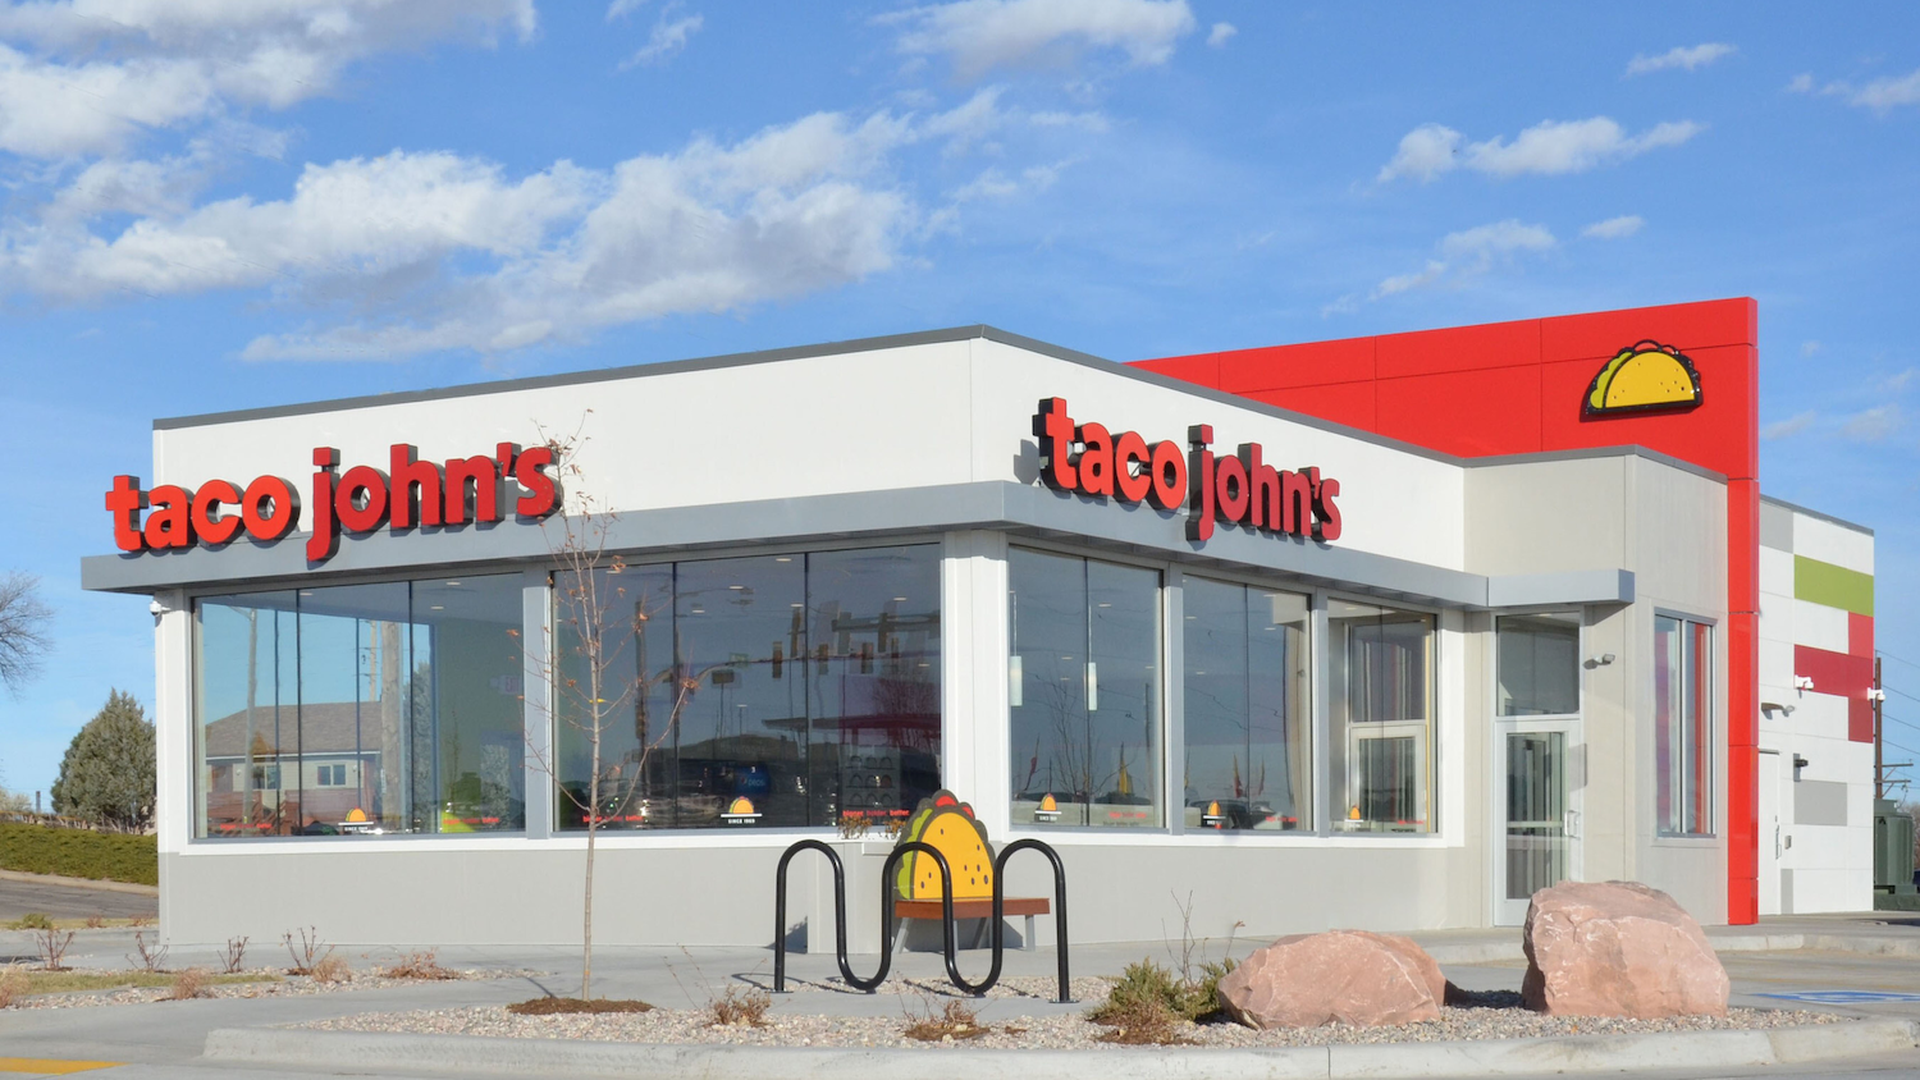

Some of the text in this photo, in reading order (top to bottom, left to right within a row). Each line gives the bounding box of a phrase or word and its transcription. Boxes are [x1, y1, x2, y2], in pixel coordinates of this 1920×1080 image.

[105, 442, 560, 561] taco john's
[1033, 397, 1342, 541] taco john's
